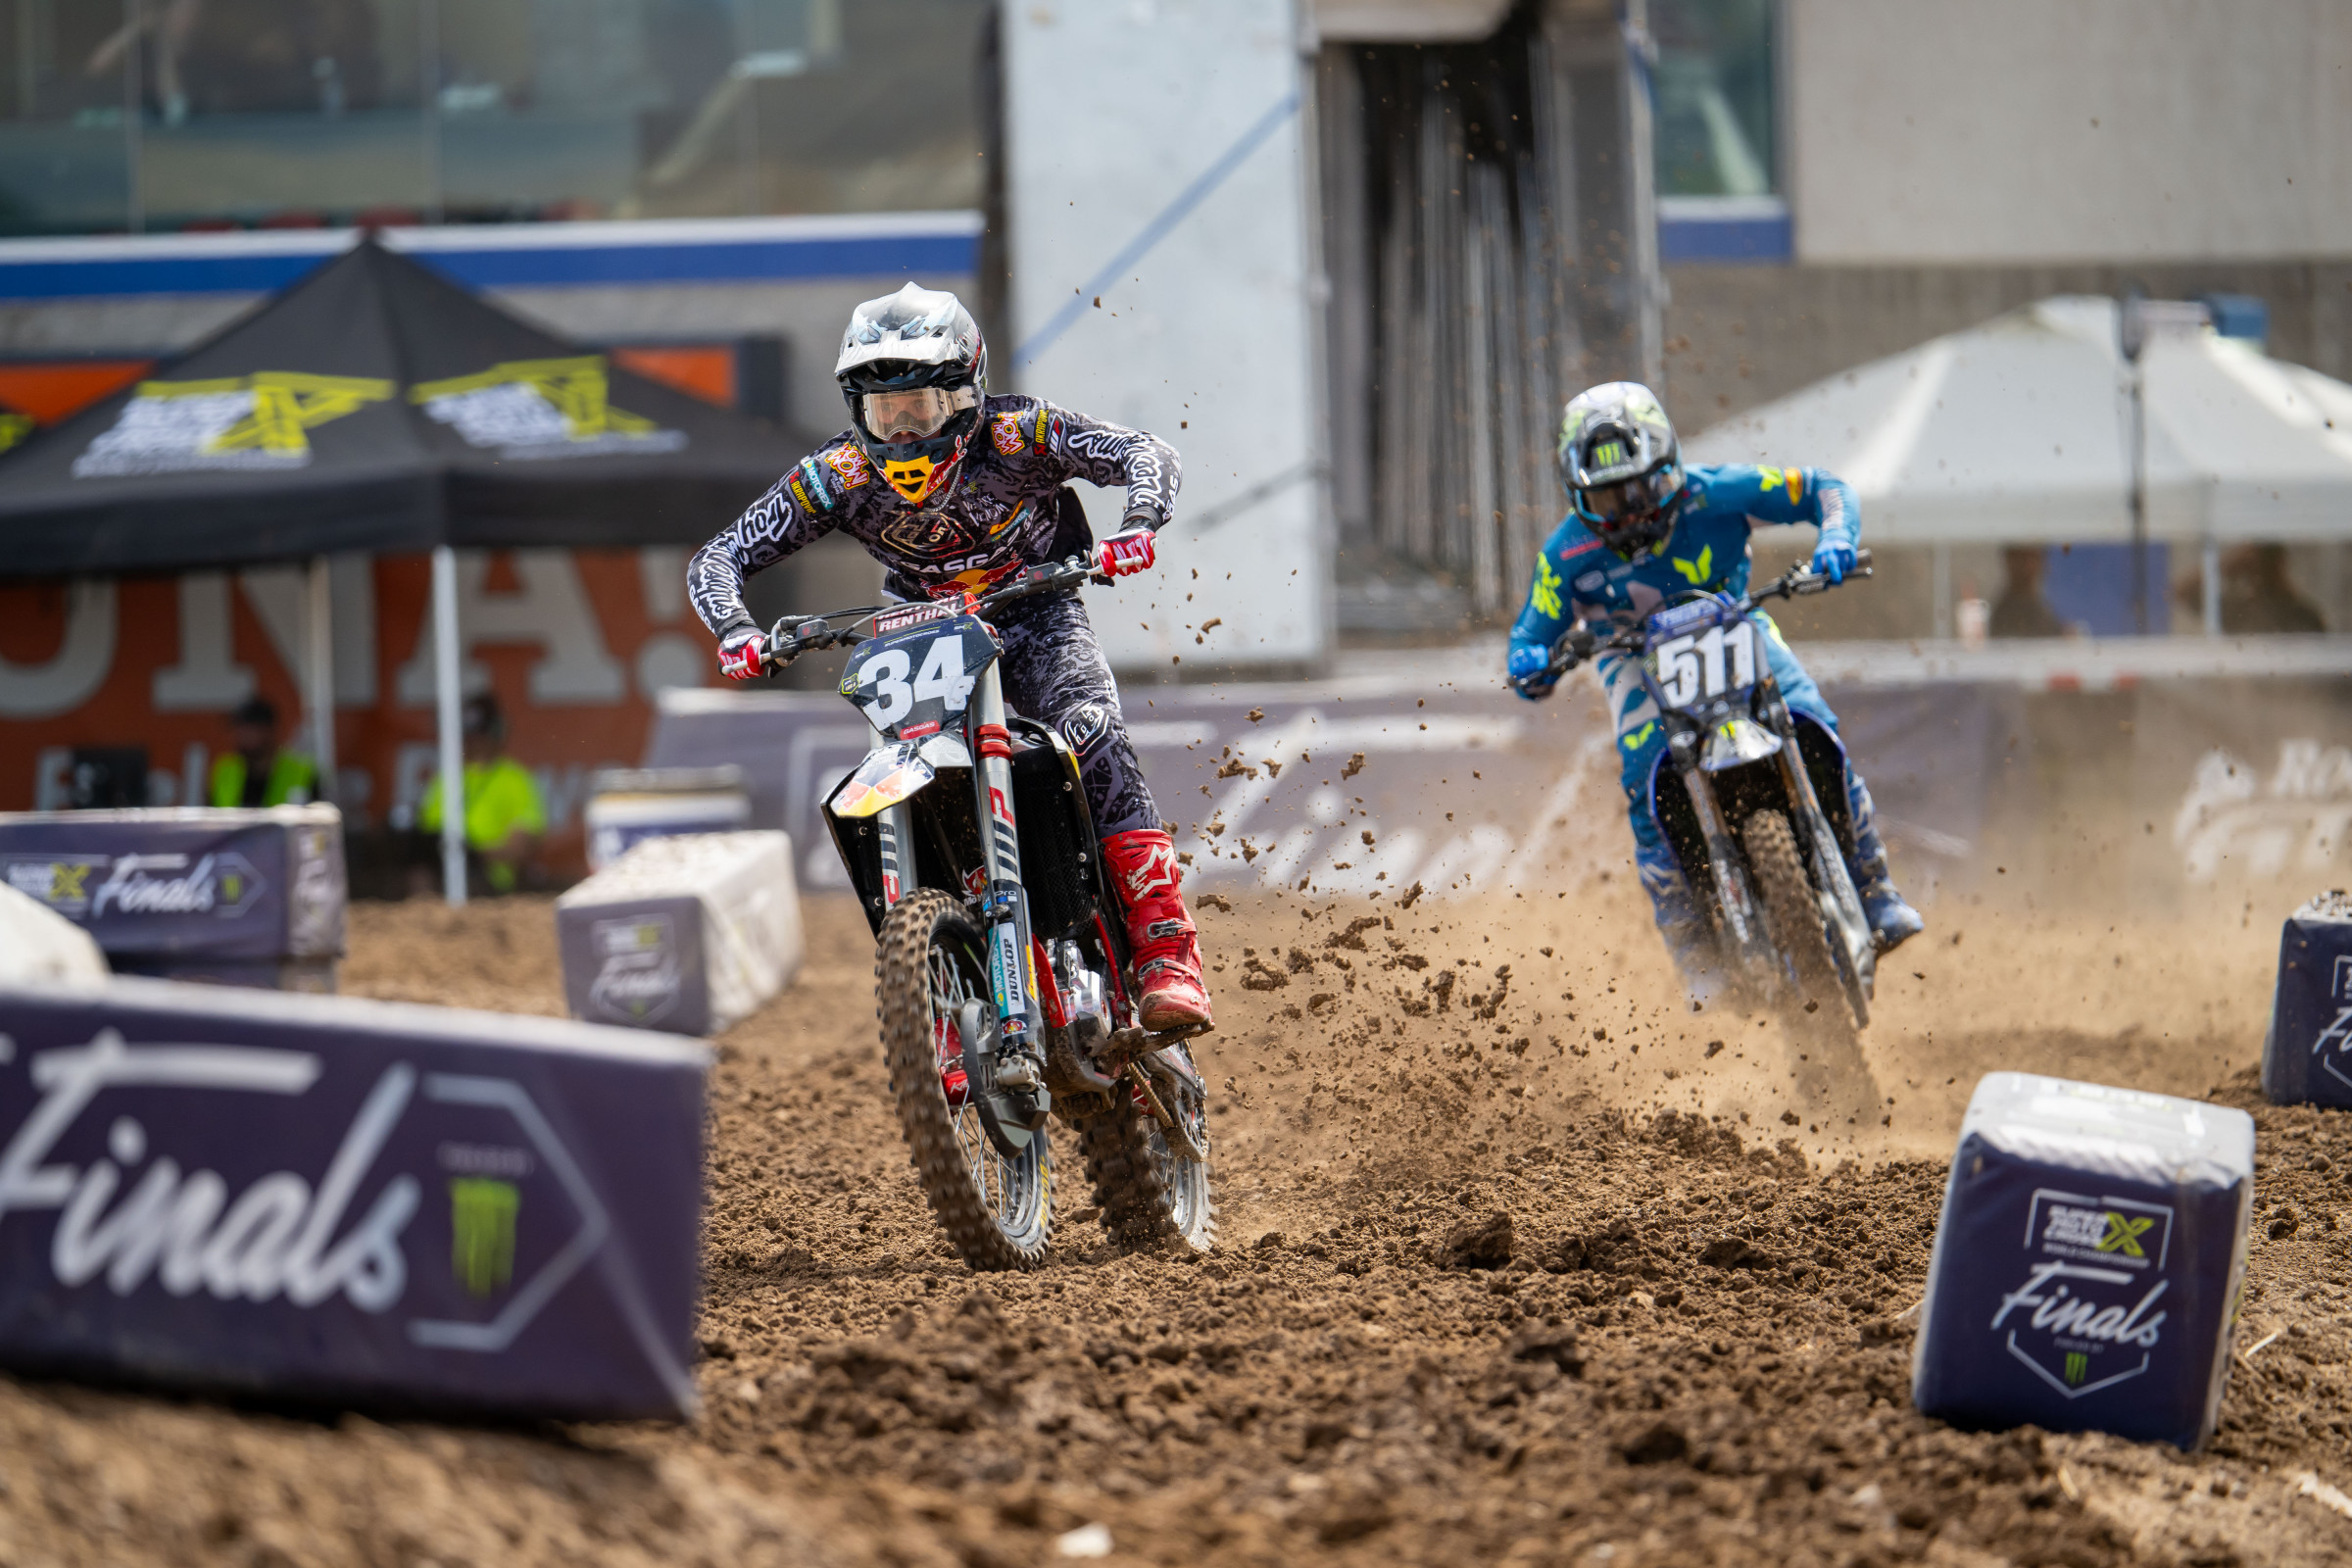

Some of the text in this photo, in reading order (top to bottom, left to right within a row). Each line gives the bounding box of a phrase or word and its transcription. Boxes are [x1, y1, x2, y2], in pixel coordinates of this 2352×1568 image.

[806, 466, 832, 509] MOTOREX
[878, 602, 958, 633] RENTHAL
[858, 634, 976, 731] 34
[1657, 621, 1755, 709] 511
[903, 722, 936, 735] GASGAS
[1004, 938, 1019, 1002] DUNLOP
[0, 1026, 423, 1315] Finals
[1991, 1258, 2169, 1348] Finals
